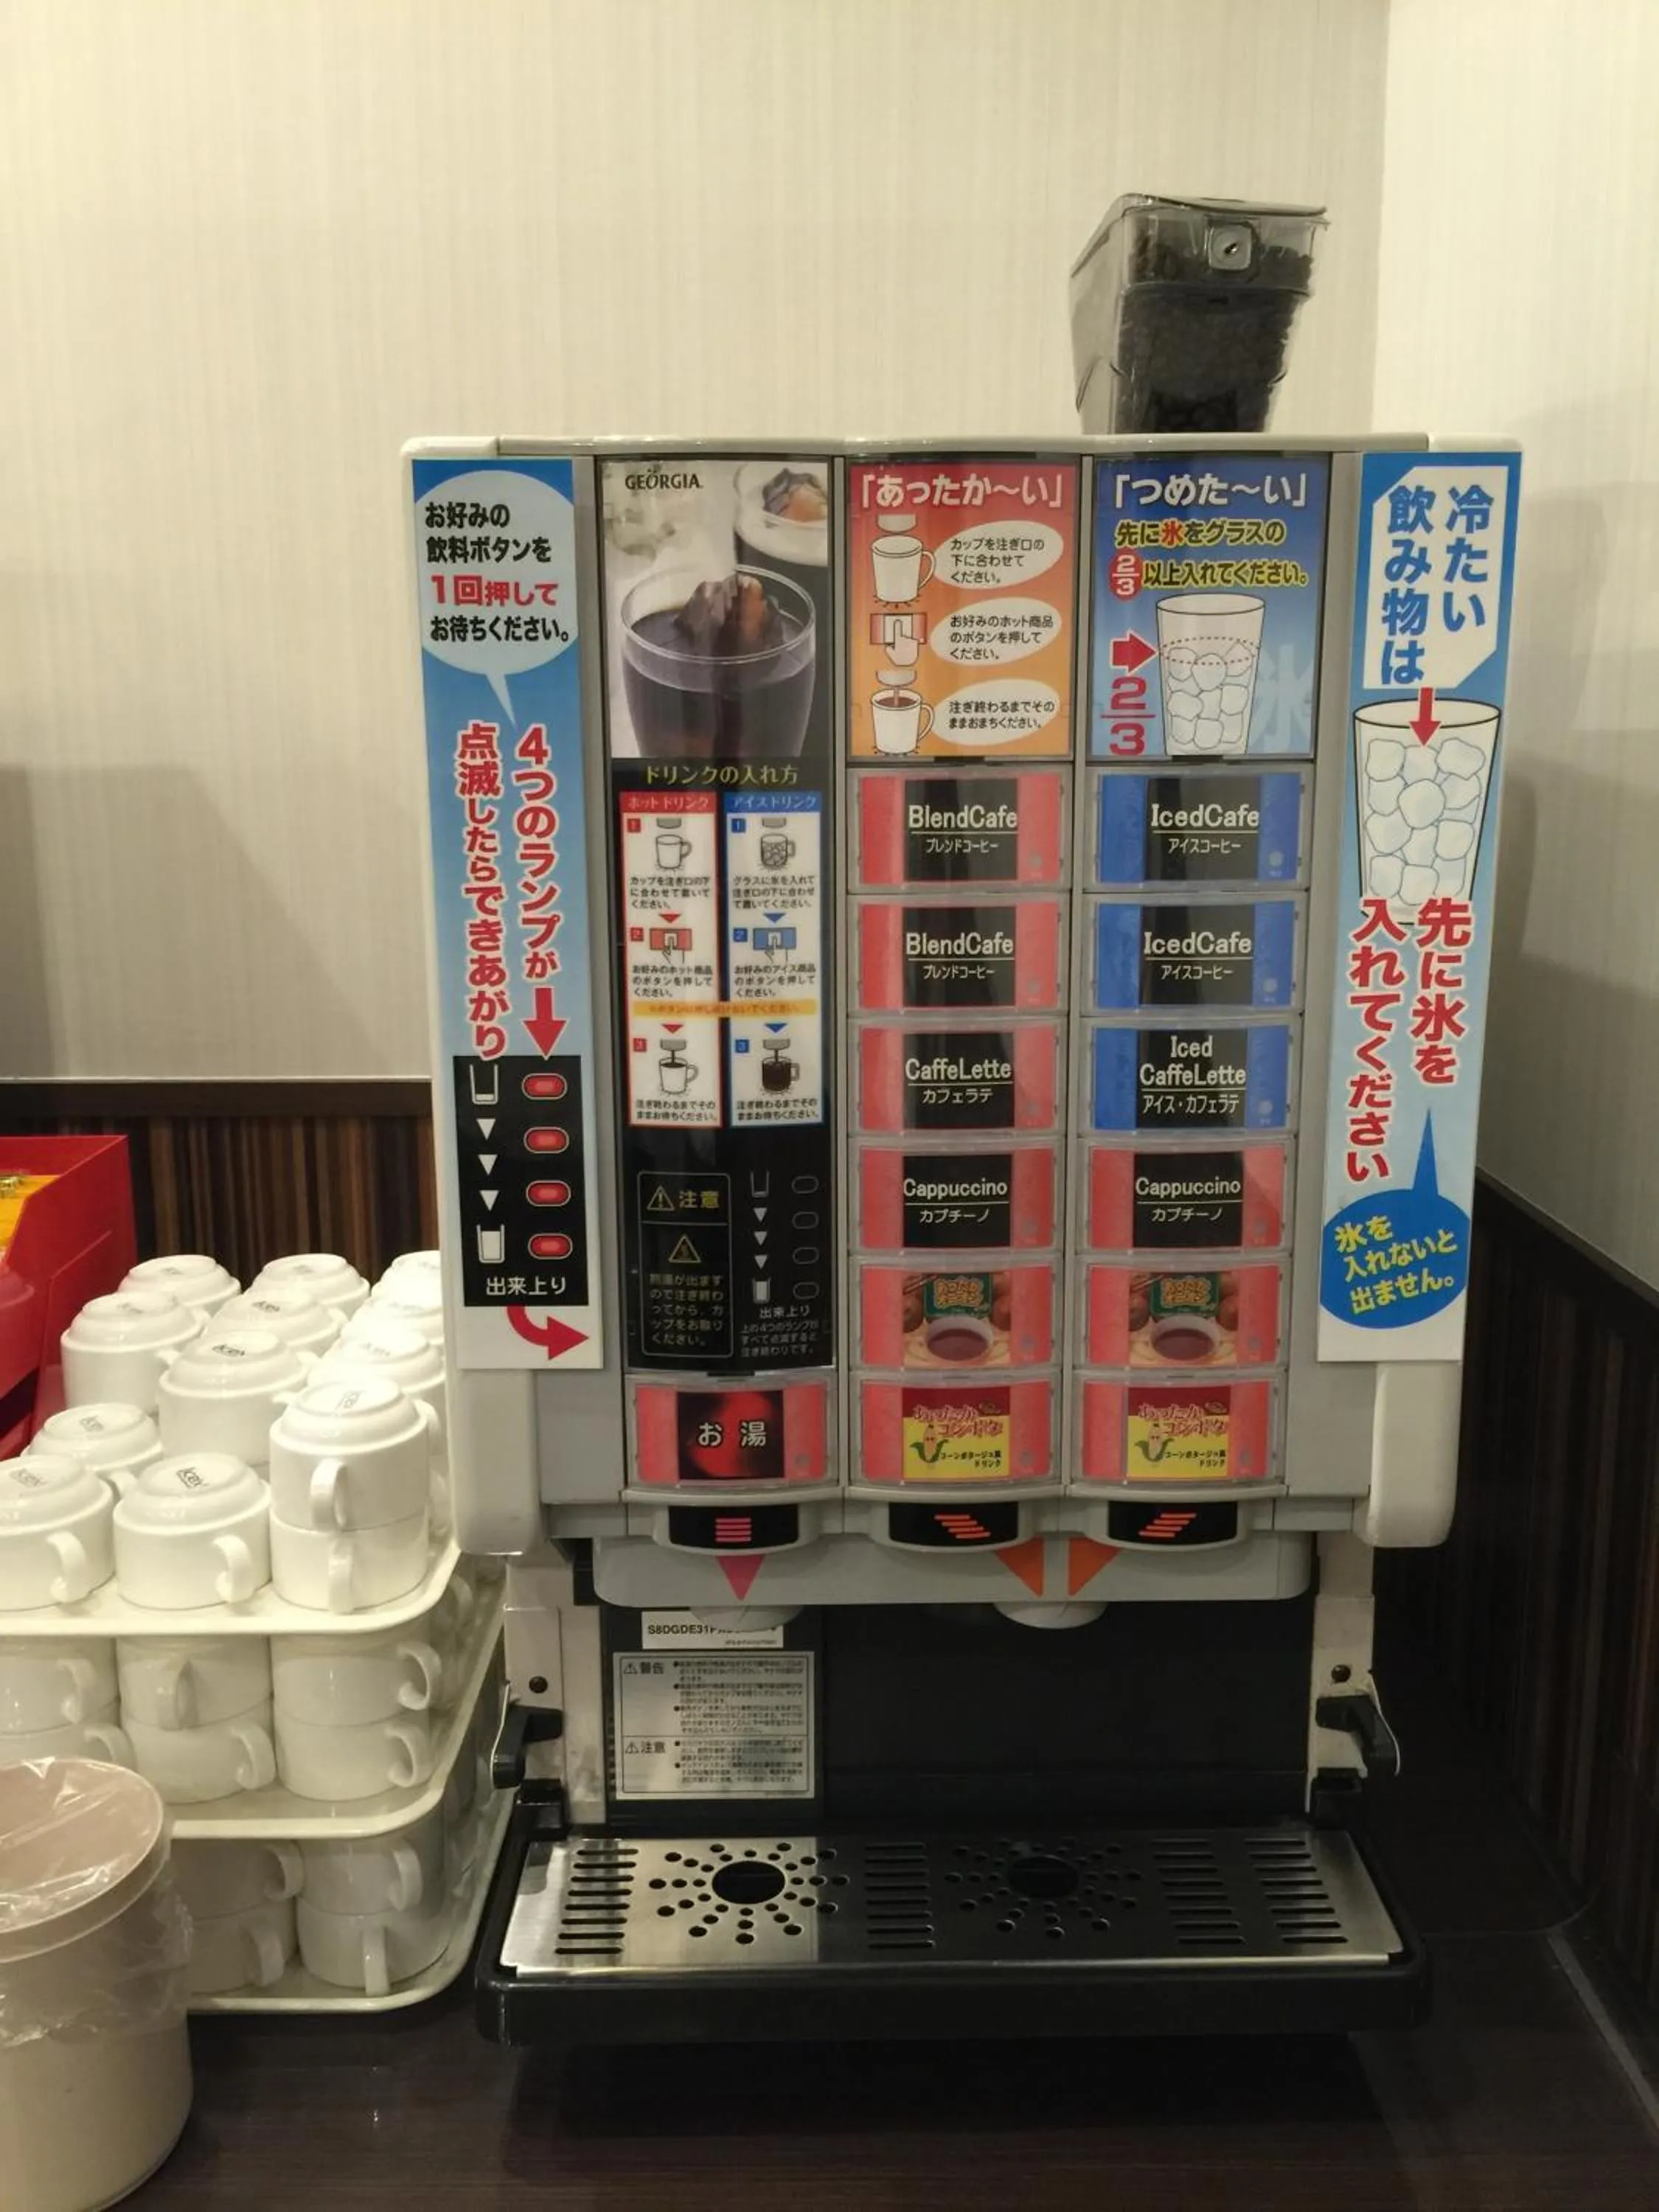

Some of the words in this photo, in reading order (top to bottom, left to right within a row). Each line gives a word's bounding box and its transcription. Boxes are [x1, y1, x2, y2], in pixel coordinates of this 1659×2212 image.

[425, 501, 510, 529] お好みの
[950, 538, 1044, 552] カップを注ぎ口の
[1116, 520, 1286, 546] 先に氷をグラスの
[426, 536, 552, 563] 飲料ボタンを
[951, 554, 1024, 567] 下に合わせて
[1443, 484, 1494, 632] 冷たい
[950, 571, 1001, 584] ください。
[1143, 560, 1309, 587] 以上入れてください。
[1381, 485, 1436, 685] 飲み物は
[431, 574, 559, 606] 1回押して
[430, 615, 569, 642] お待ちください。
[950, 615, 1054, 628] お好みのホット商品
[950, 632, 1042, 644] のボタンを押して
[950, 647, 1000, 660] ください。
[949, 700, 1054, 713] 注ぎ終わるまでその
[949, 717, 1042, 729] ままおまちください。
[647, 765, 799, 785] ドリンクの入れ方
[908, 804, 1018, 829] BlendCafe
[1150, 803, 1260, 827] IcedCafe
[514, 726, 561, 980] 4つのランプが
[925, 838, 998, 853] ブレンドコーヒー
[1168, 838, 1242, 854] アイスコーヒー
[457, 722, 510, 1059] 点滅したらできあがり
[905, 932, 1015, 956] BlendCafe
[1144, 931, 1252, 955] IcedCafe
[922, 964, 995, 980] ブレンドコーヒー
[1161, 964, 1234, 980] アイスコーヒー
[1410, 896, 1474, 1085] 先に氷を
[1170, 1034, 1213, 1058] Iced
[1346, 897, 1408, 1181] 入れてください
[905, 1057, 1012, 1081] CaffeLette
[1139, 1063, 1247, 1086] CaffeLette
[922, 1088, 993, 1104] カフェラテ
[903, 1178, 1008, 1200] Cappuccino
[1135, 1175, 1241, 1198] Cappuccino
[678, 1190, 720, 1208] 注意
[919, 1208, 990, 1223] カプチーノ
[1152, 1207, 1222, 1222] カプチーノ
[1334, 1214, 1394, 1254] 氷を
[1343, 1230, 1458, 1282] 入れないと
[486, 1276, 566, 1296] 出来上り
[1349, 1267, 1455, 1317] 出ません。
[698, 1422, 767, 1447] お湯
